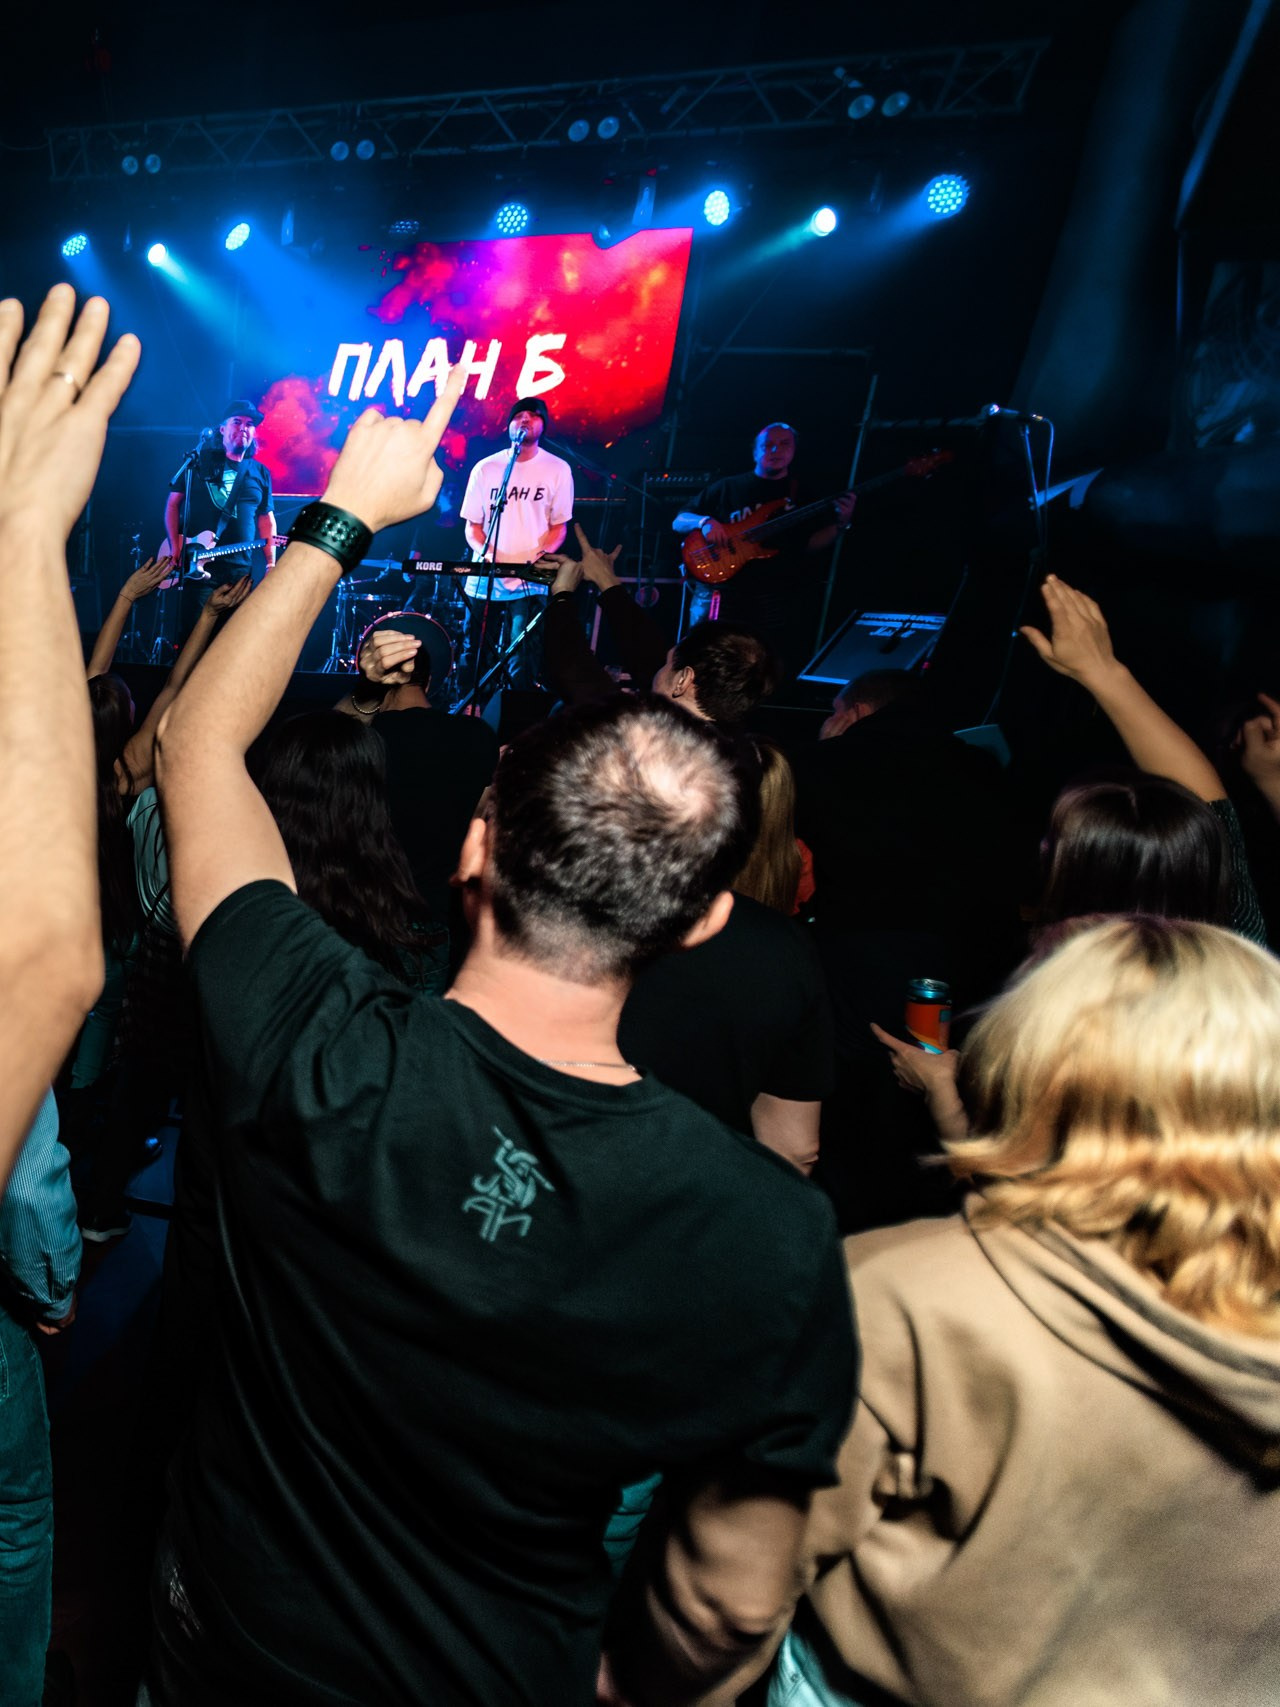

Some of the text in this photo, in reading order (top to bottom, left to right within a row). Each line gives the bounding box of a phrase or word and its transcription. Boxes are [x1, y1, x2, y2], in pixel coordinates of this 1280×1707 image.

[328, 333, 567, 407] ПЛАН Б
[533, 487, 545, 501] Б
[416, 561, 443, 571] KORG
